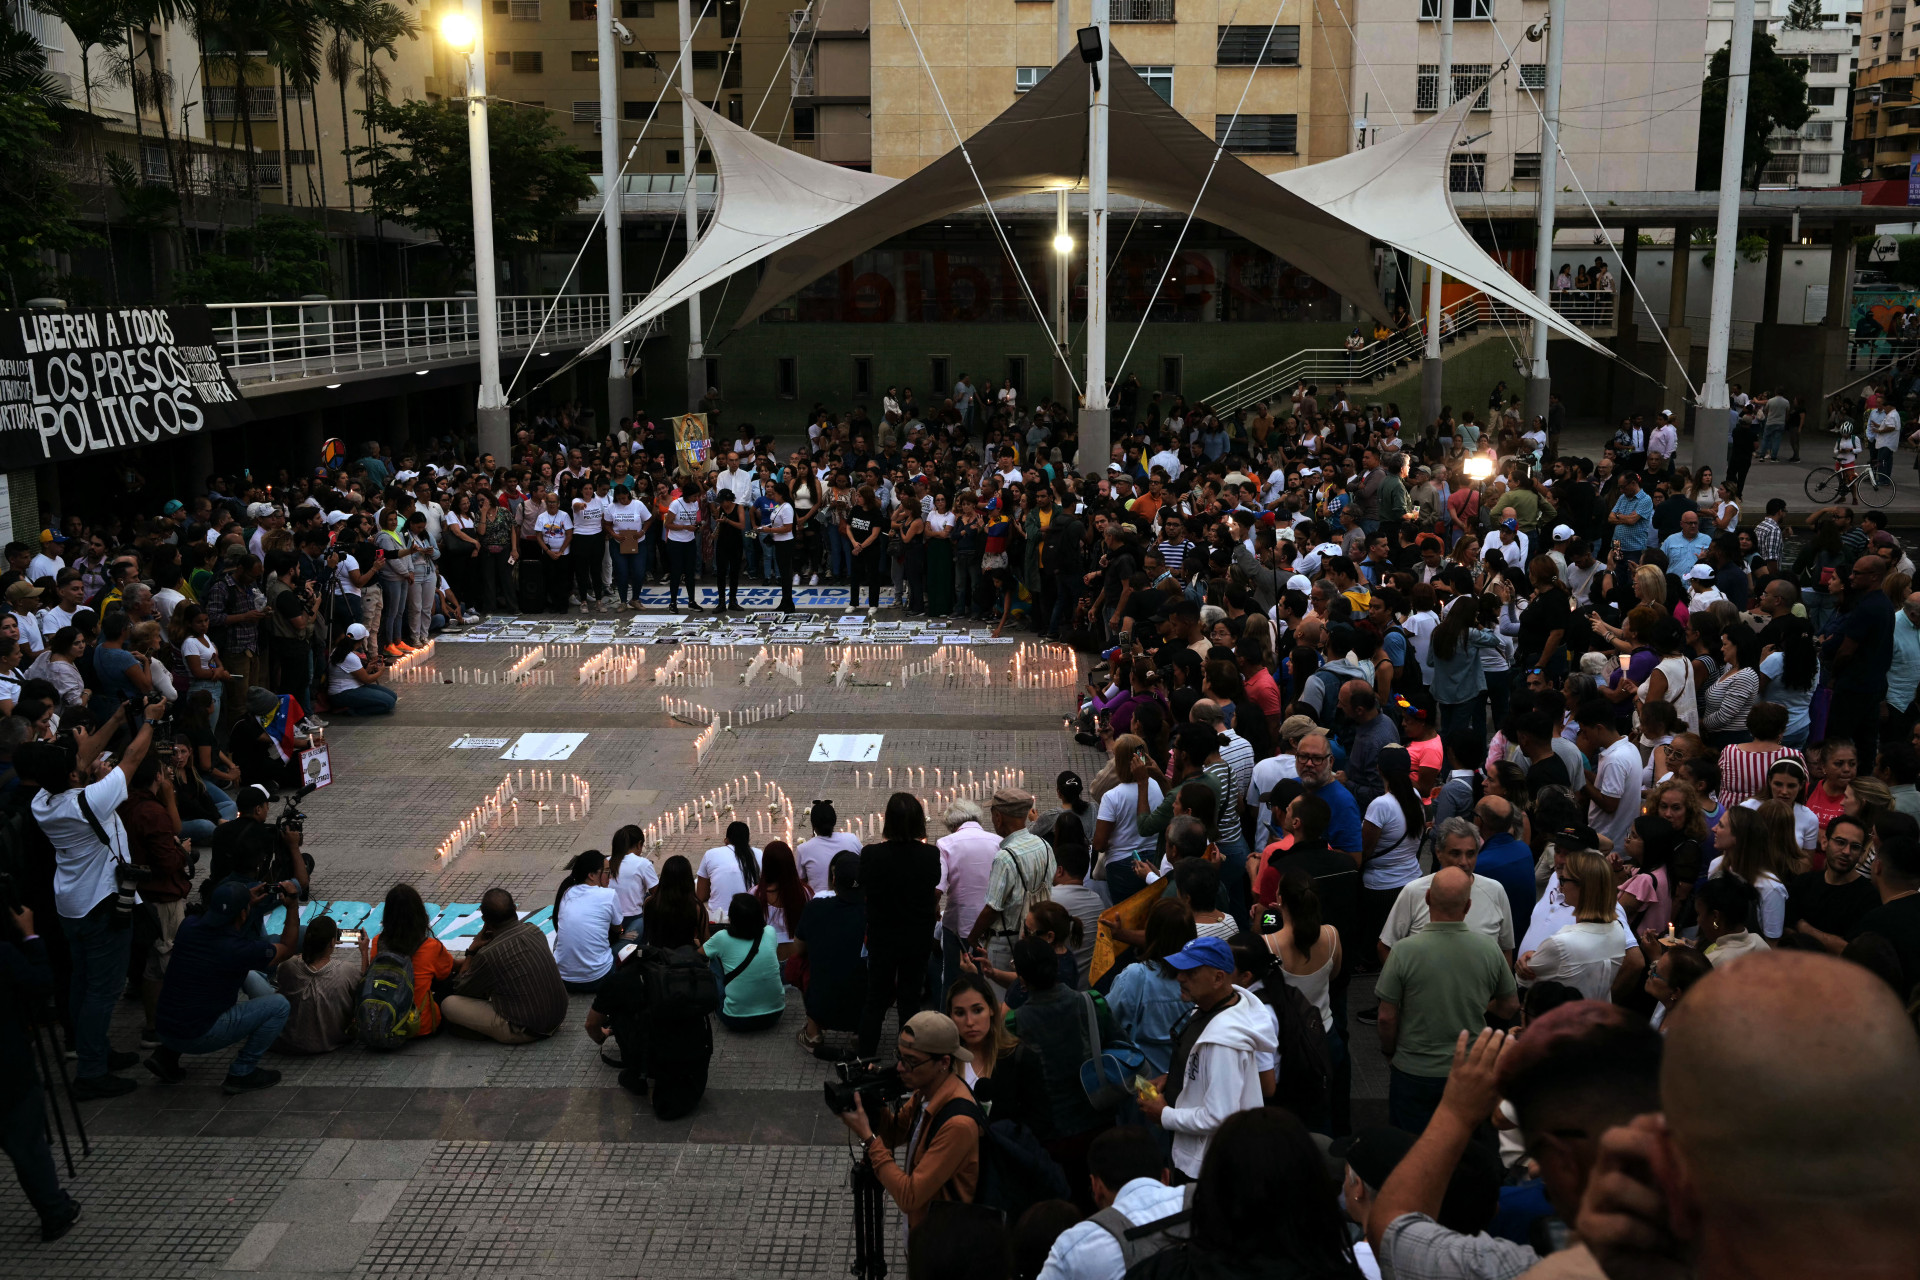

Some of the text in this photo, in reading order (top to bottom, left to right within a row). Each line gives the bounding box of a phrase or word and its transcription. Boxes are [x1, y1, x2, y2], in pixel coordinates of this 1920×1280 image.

[19, 309, 175, 354] LIBEREN A TODOS
[28, 345, 192, 405] LOS PRESOS
[192, 381, 238, 404] TORTURA
[639, 588, 850, 597] LA VERDAD
[639, 597, 689, 605] NOS
[700, 596, 775, 605] HRÁ
[1263, 913, 1277, 925] 25
